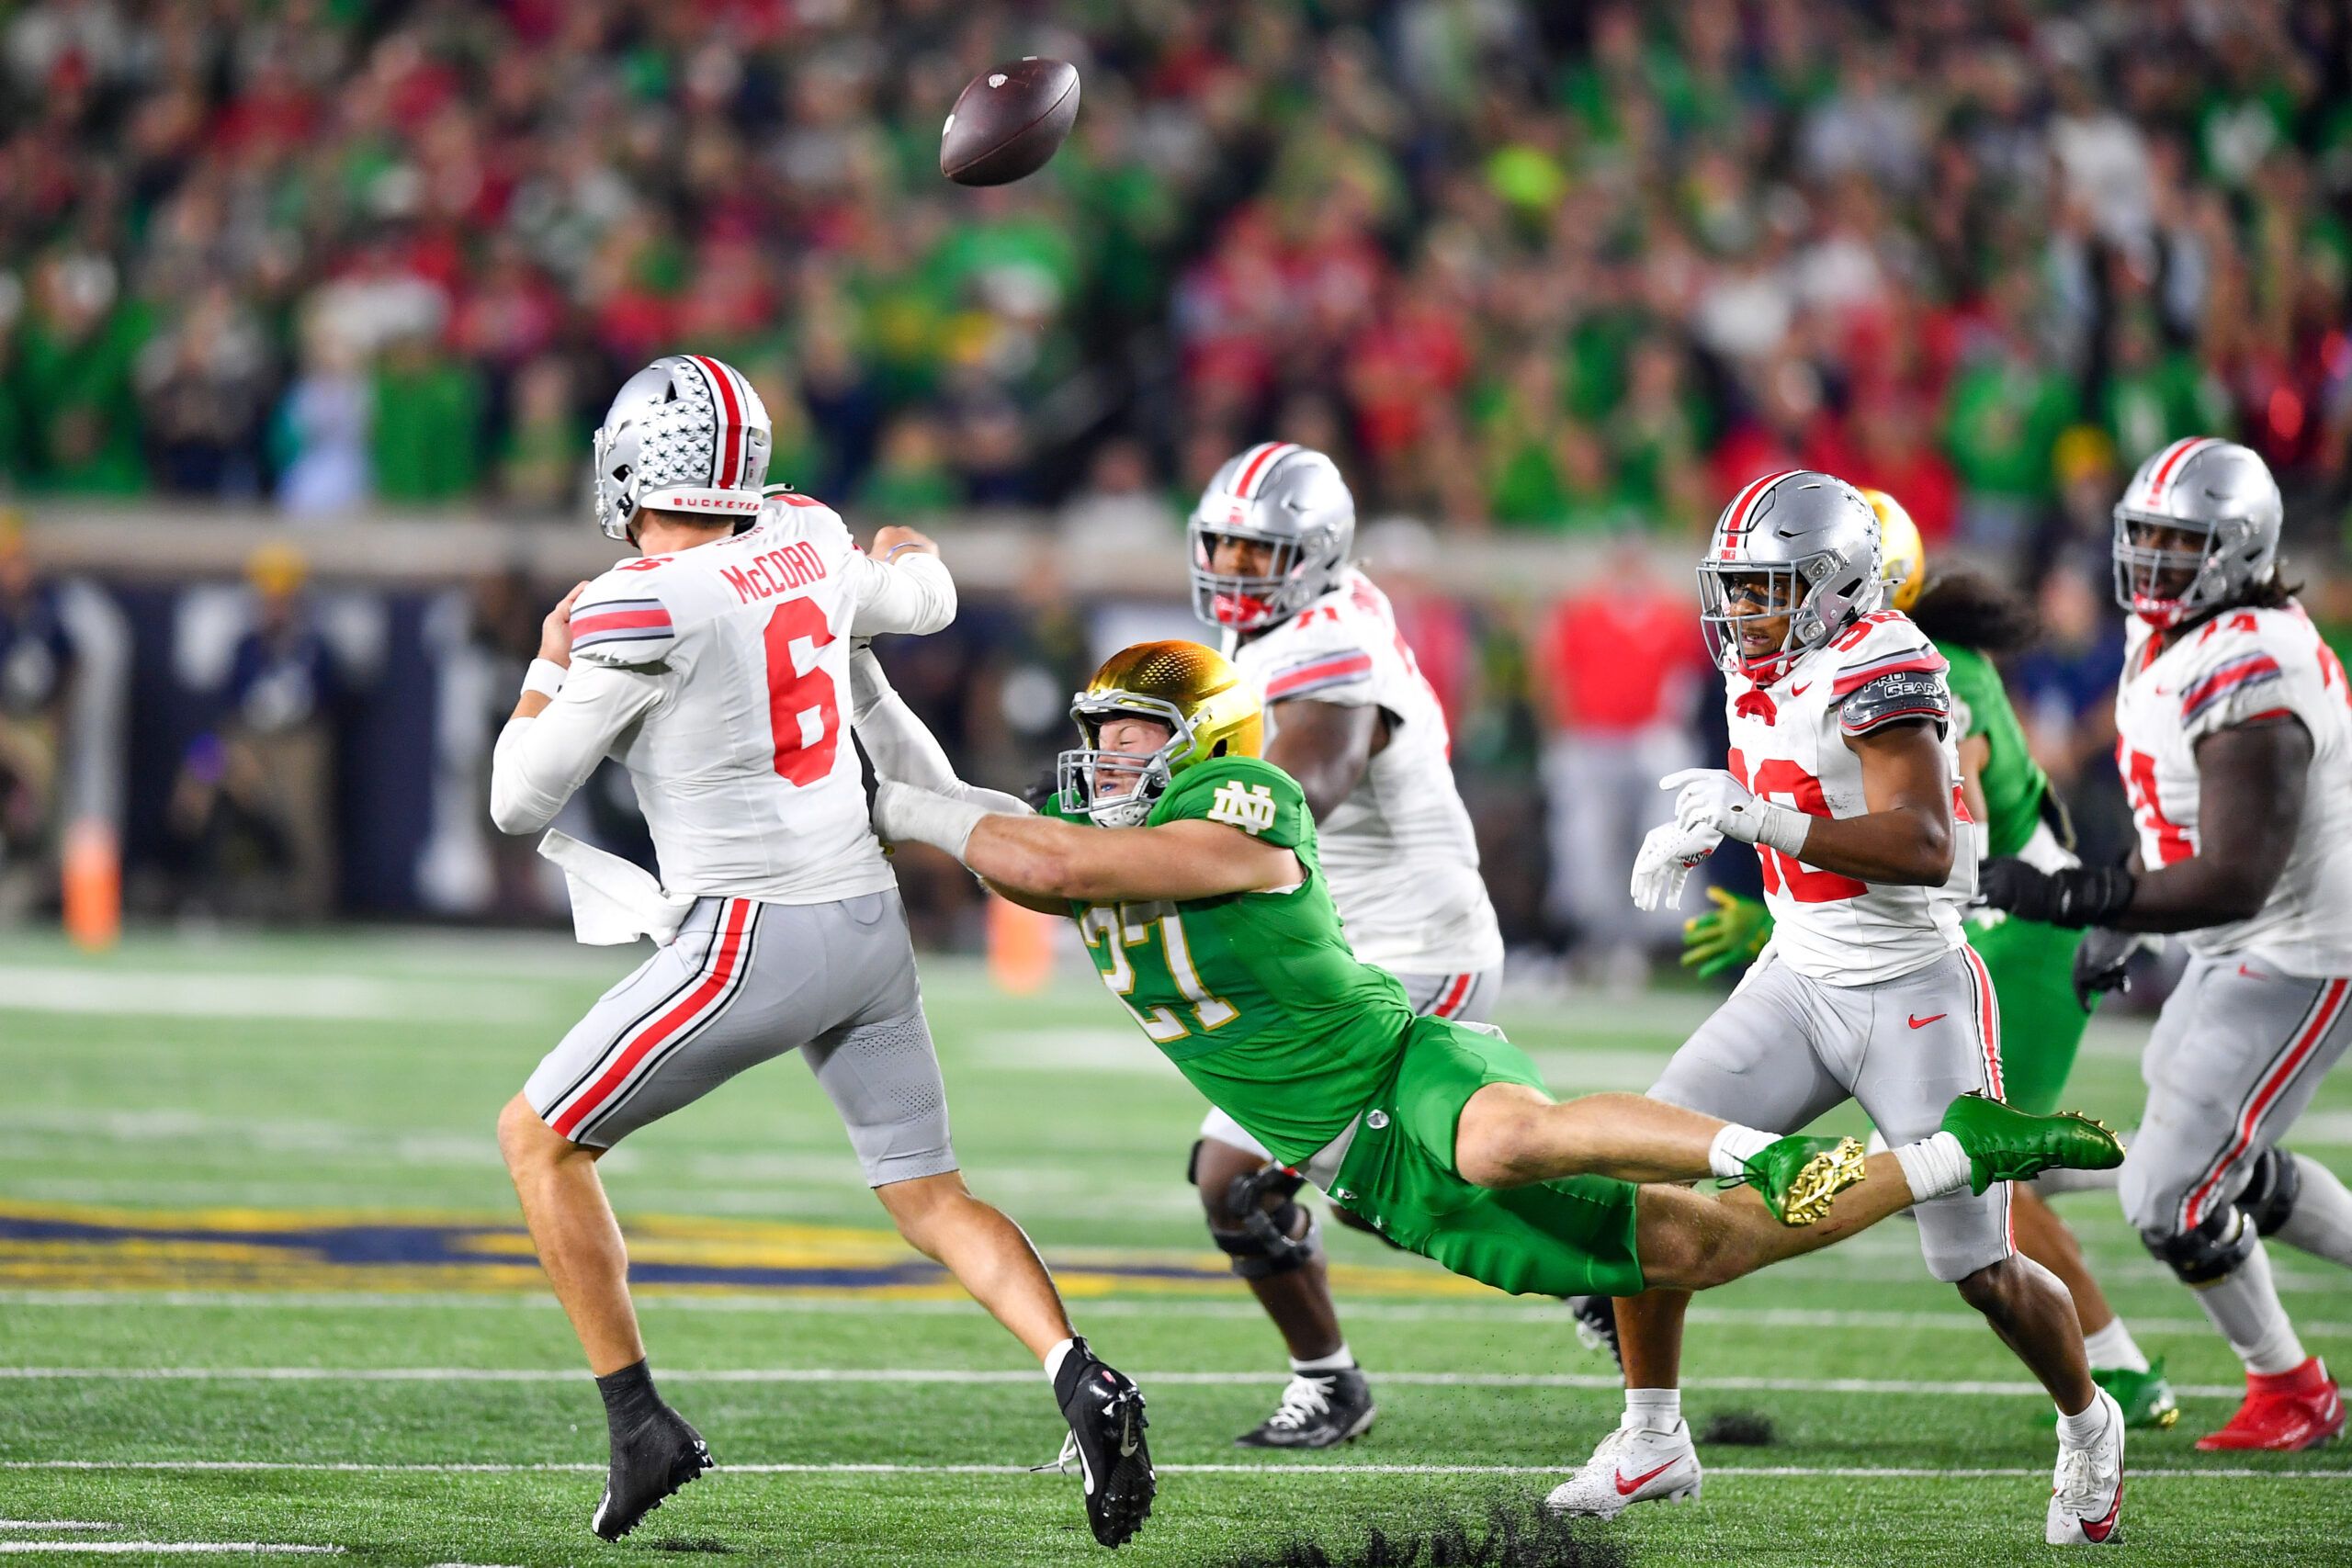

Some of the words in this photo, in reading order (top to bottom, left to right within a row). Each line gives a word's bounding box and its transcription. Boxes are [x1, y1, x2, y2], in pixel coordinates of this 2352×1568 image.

[673, 498, 760, 512] BUCKEYES
[763, 596, 840, 787] 6
[1884, 682, 1939, 699] GEAR
[1080, 901, 1241, 1043] 27
